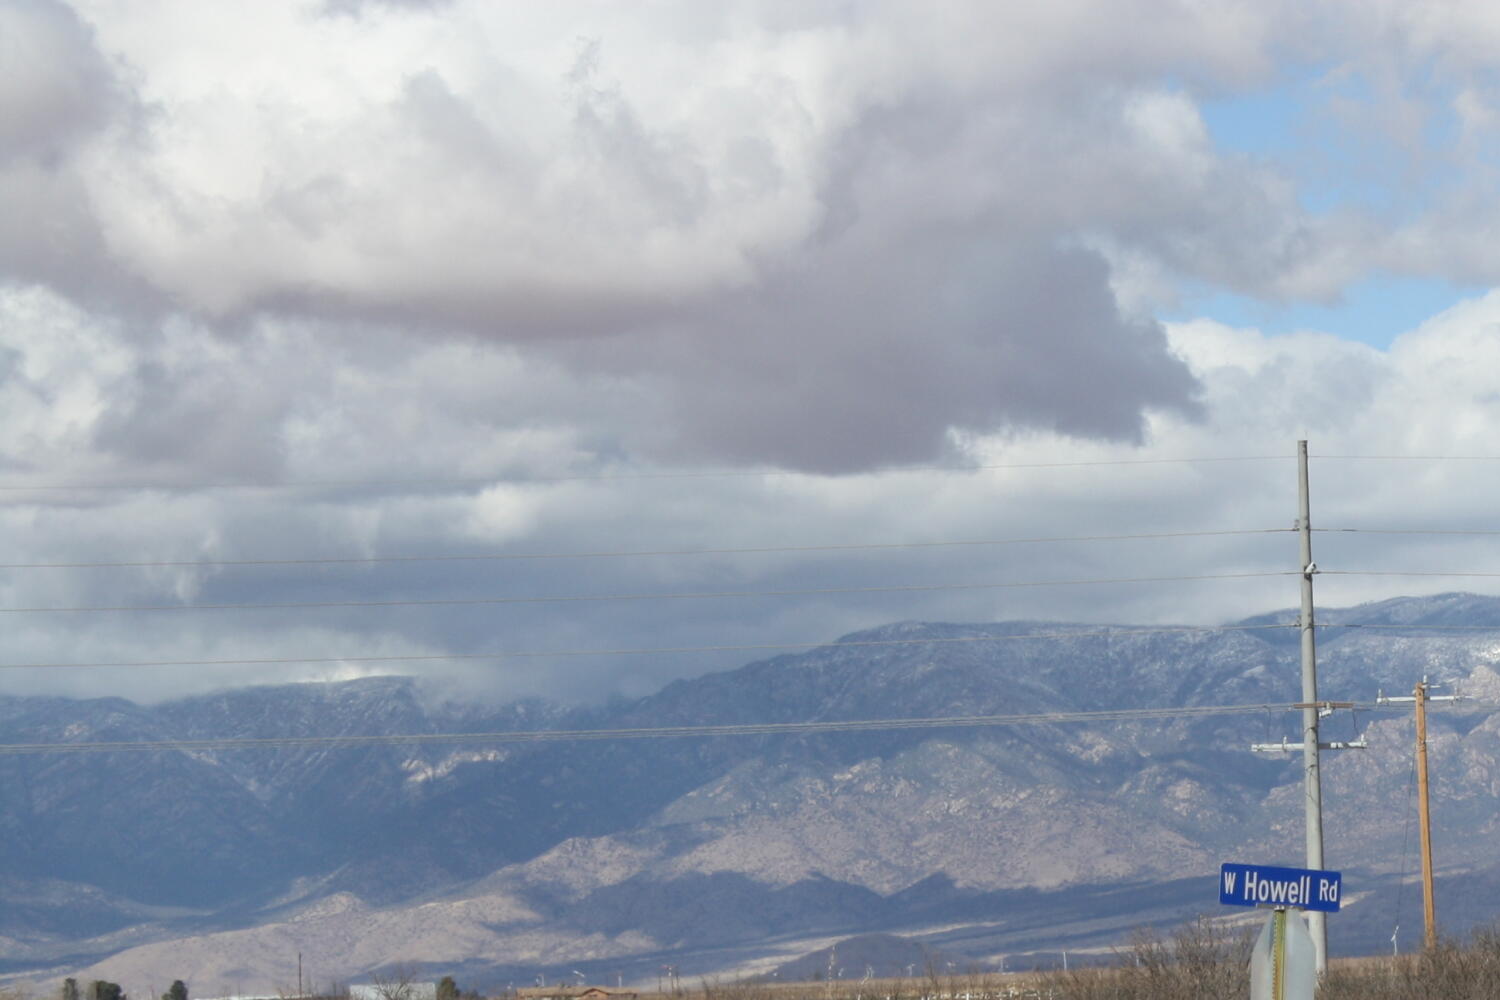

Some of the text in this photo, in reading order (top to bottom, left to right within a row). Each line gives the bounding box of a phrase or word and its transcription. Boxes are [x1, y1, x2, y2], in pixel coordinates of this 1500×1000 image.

[1224, 871, 1338, 904] W Howell Rd
